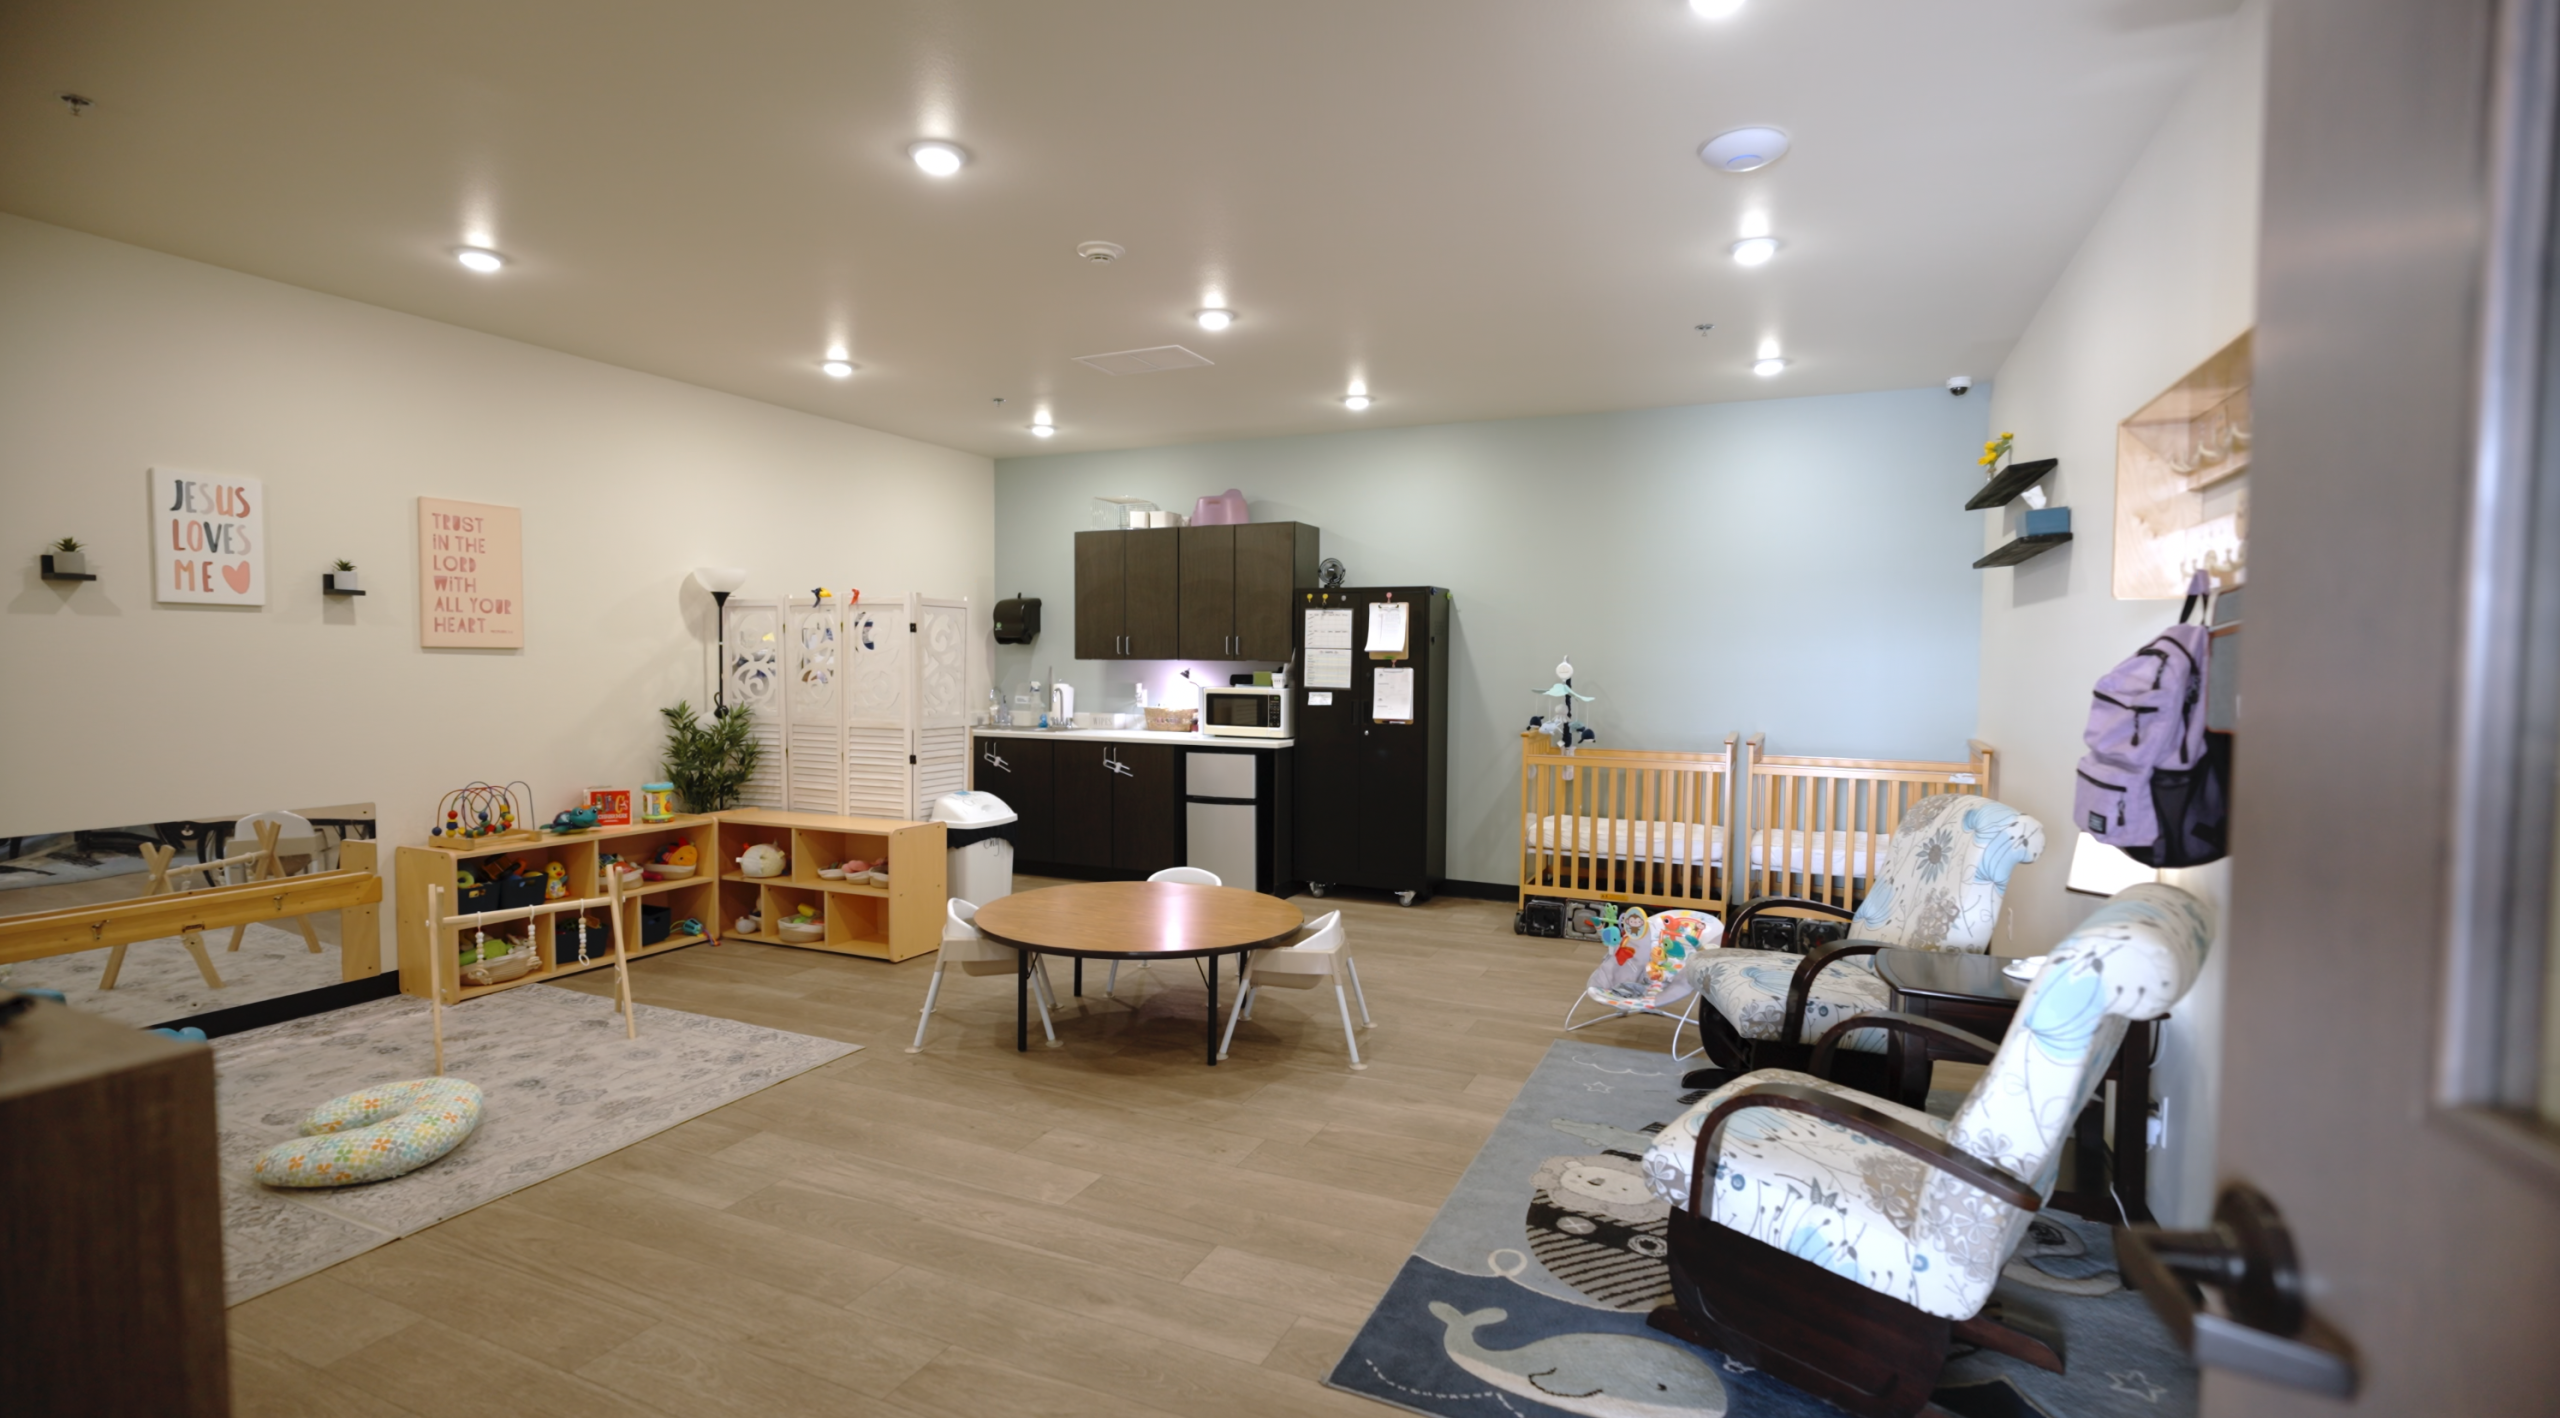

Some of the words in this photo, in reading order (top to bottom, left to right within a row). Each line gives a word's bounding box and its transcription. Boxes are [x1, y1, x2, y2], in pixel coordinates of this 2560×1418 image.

[169, 479, 251, 518] JESUS
[432, 512, 484, 534] TRUST
[172, 518, 252, 556] LOVES
[455, 535, 486, 554] THE
[433, 554, 477, 573] LORD
[174, 559, 214, 593] ME
[434, 596, 463, 613] ALL
[470, 597, 512, 615] YOUR
[434, 616, 486, 634] HEART
[1093, 716, 1113, 726] WIPES
